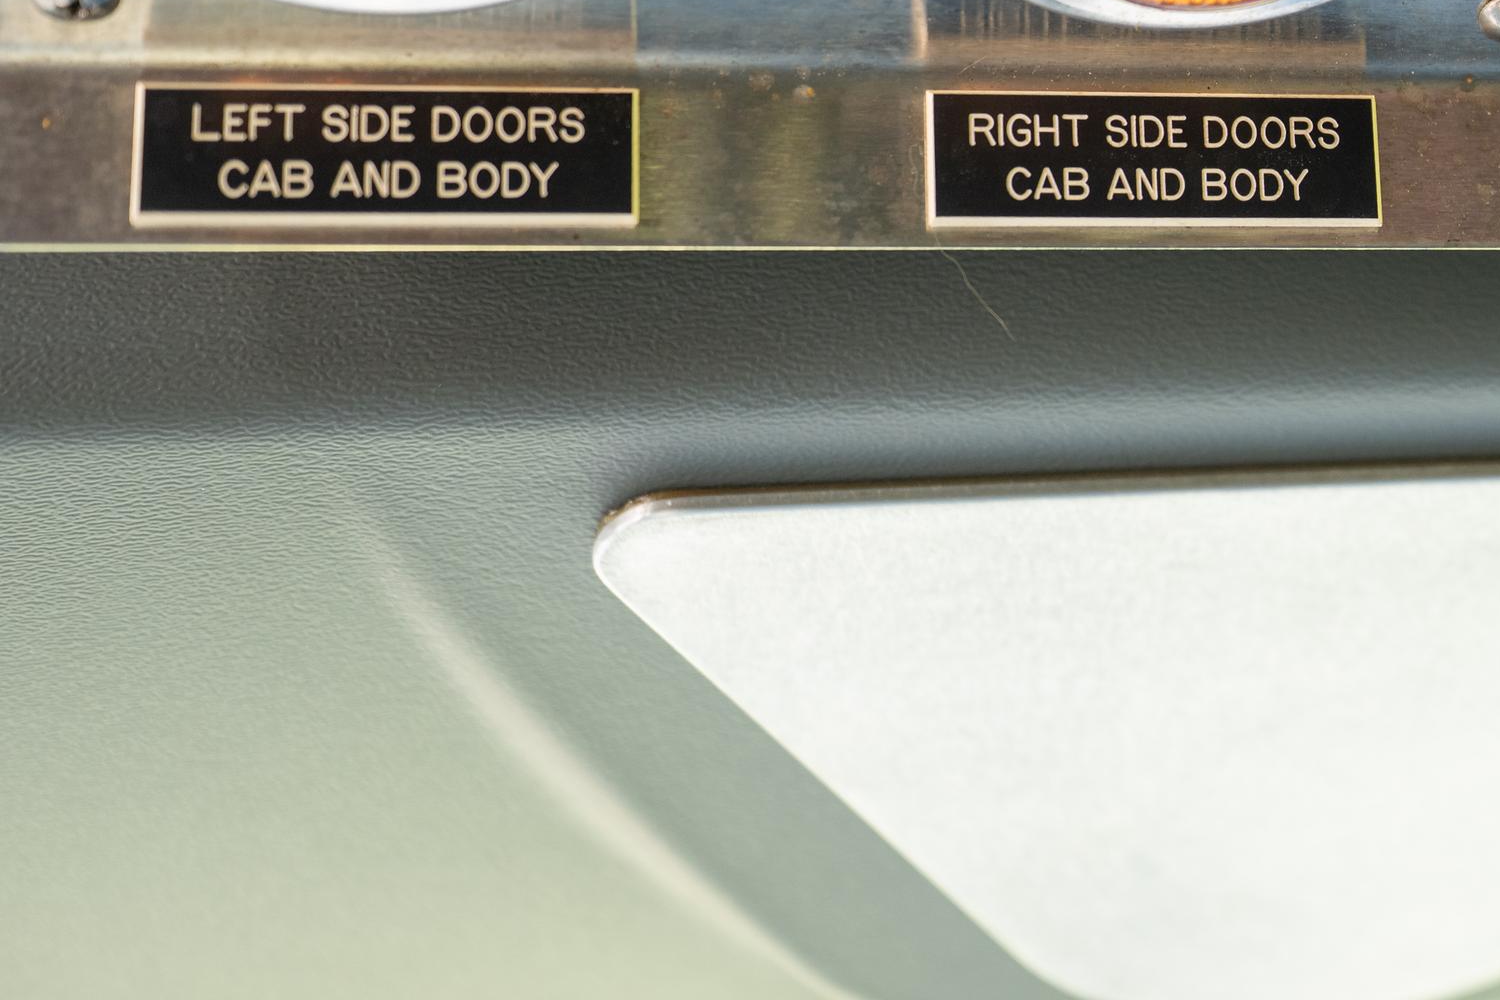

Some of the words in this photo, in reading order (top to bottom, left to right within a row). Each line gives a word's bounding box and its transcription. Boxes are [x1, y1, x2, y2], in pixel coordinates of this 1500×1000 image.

[191, 103, 306, 142] LEFT
[321, 104, 416, 143] SIDE
[430, 106, 586, 144] DOORS
[968, 113, 1089, 148] RIGHT
[1104, 114, 1187, 148] SIDE
[1202, 115, 1341, 150] DOORS
[217, 159, 315, 199] CAB
[330, 160, 422, 199] AND
[436, 160, 560, 199] BODY
[1005, 166, 1091, 201] CAB
[1106, 167, 1186, 201] AND
[1201, 167, 1309, 202] BODY
